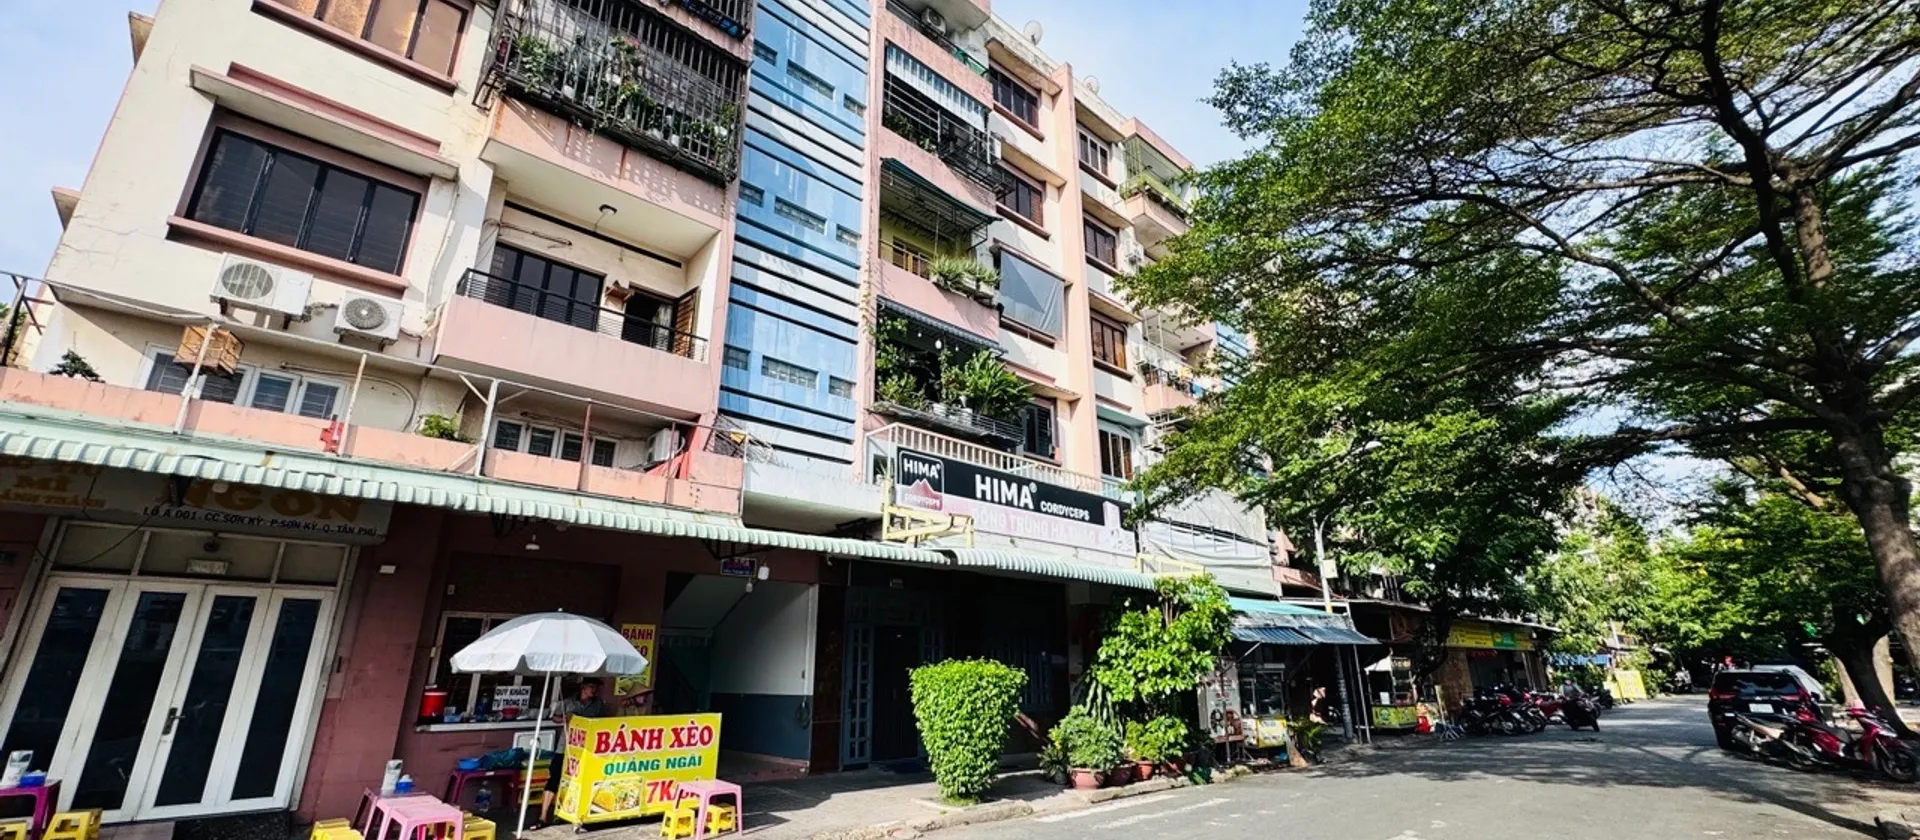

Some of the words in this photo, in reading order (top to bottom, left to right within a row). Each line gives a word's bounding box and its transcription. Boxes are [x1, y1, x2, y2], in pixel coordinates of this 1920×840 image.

[163, 508, 171, 517] A
[204, 511, 219, 522] CC
[1040, 500, 1091, 521] CORDYCEPS
[622, 626, 654, 640] BÁNH
[594, 723, 665, 754] BÁNH
[669, 719, 714, 749] XÈO
